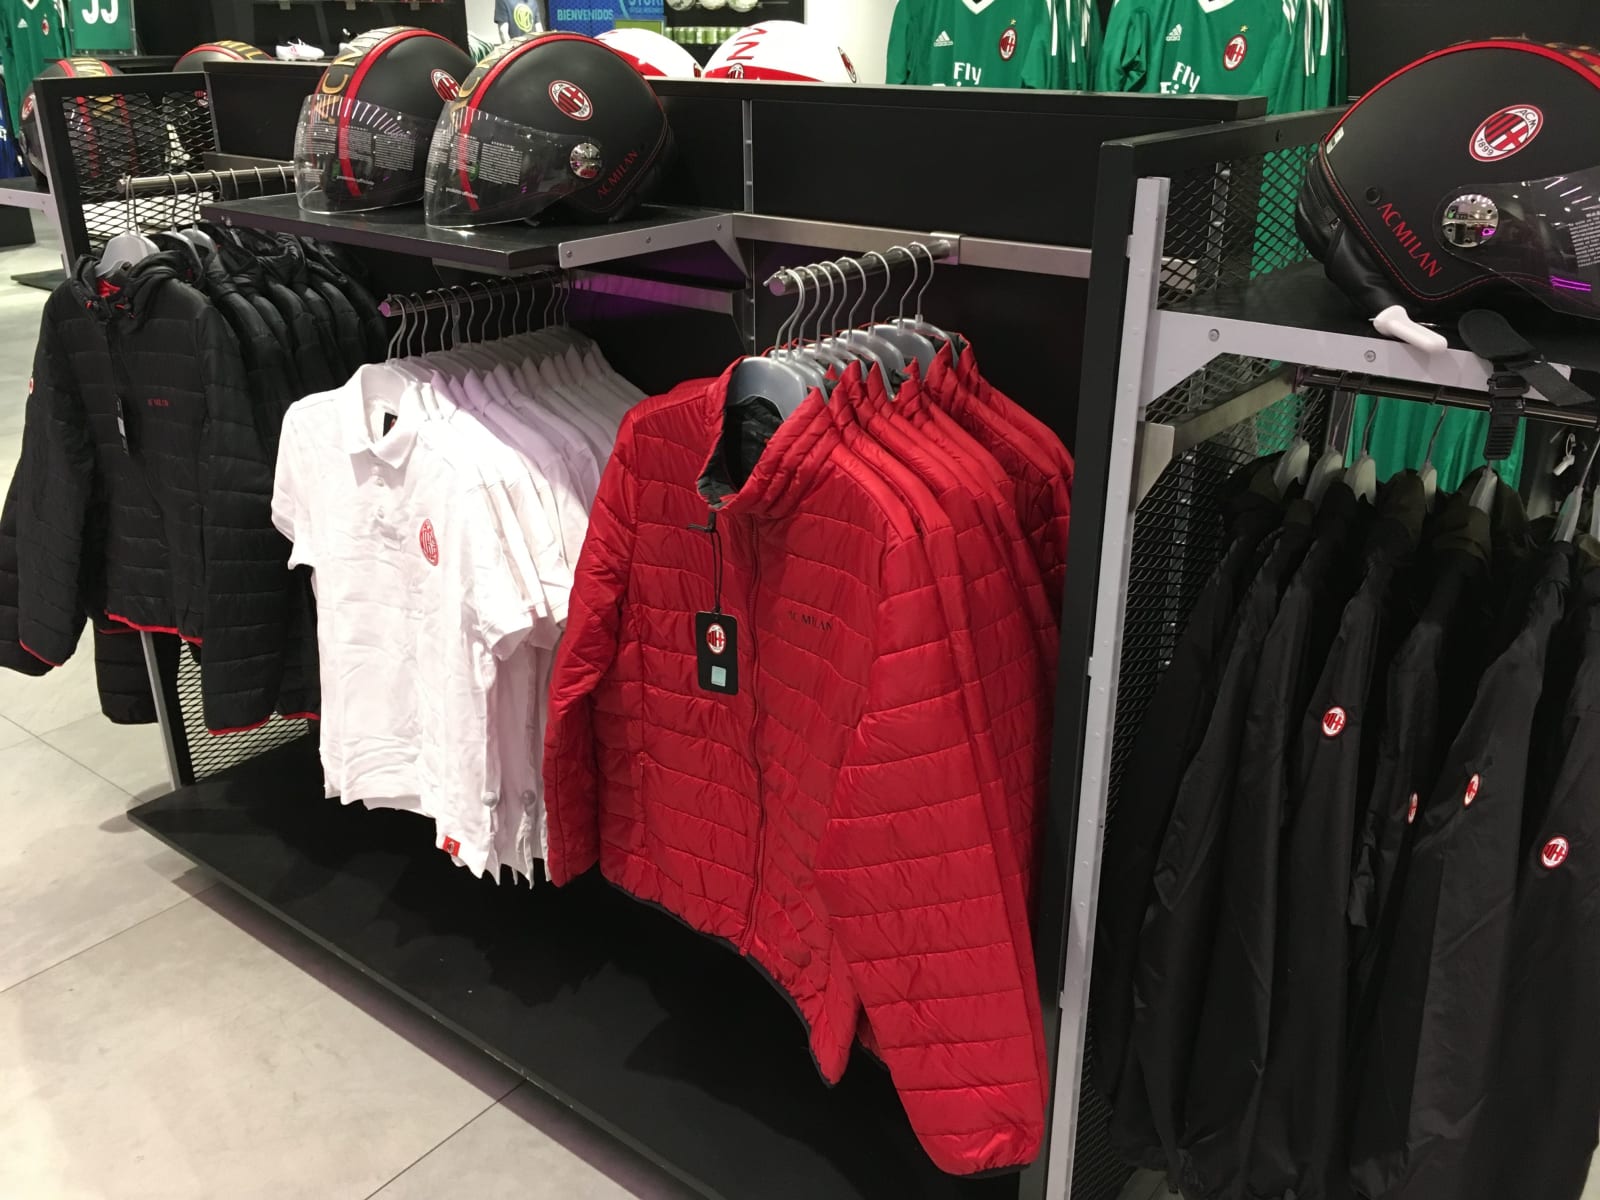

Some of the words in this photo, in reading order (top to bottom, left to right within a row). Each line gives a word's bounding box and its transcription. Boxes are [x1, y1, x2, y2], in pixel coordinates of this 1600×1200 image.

[557, 9, 613, 20] BIENVENIDOS
[953, 61, 981, 85] Fly
[1172, 61, 1200, 93] Fly
[1515, 109, 1537, 129] ACM
[1476, 137, 1494, 156] 1899
